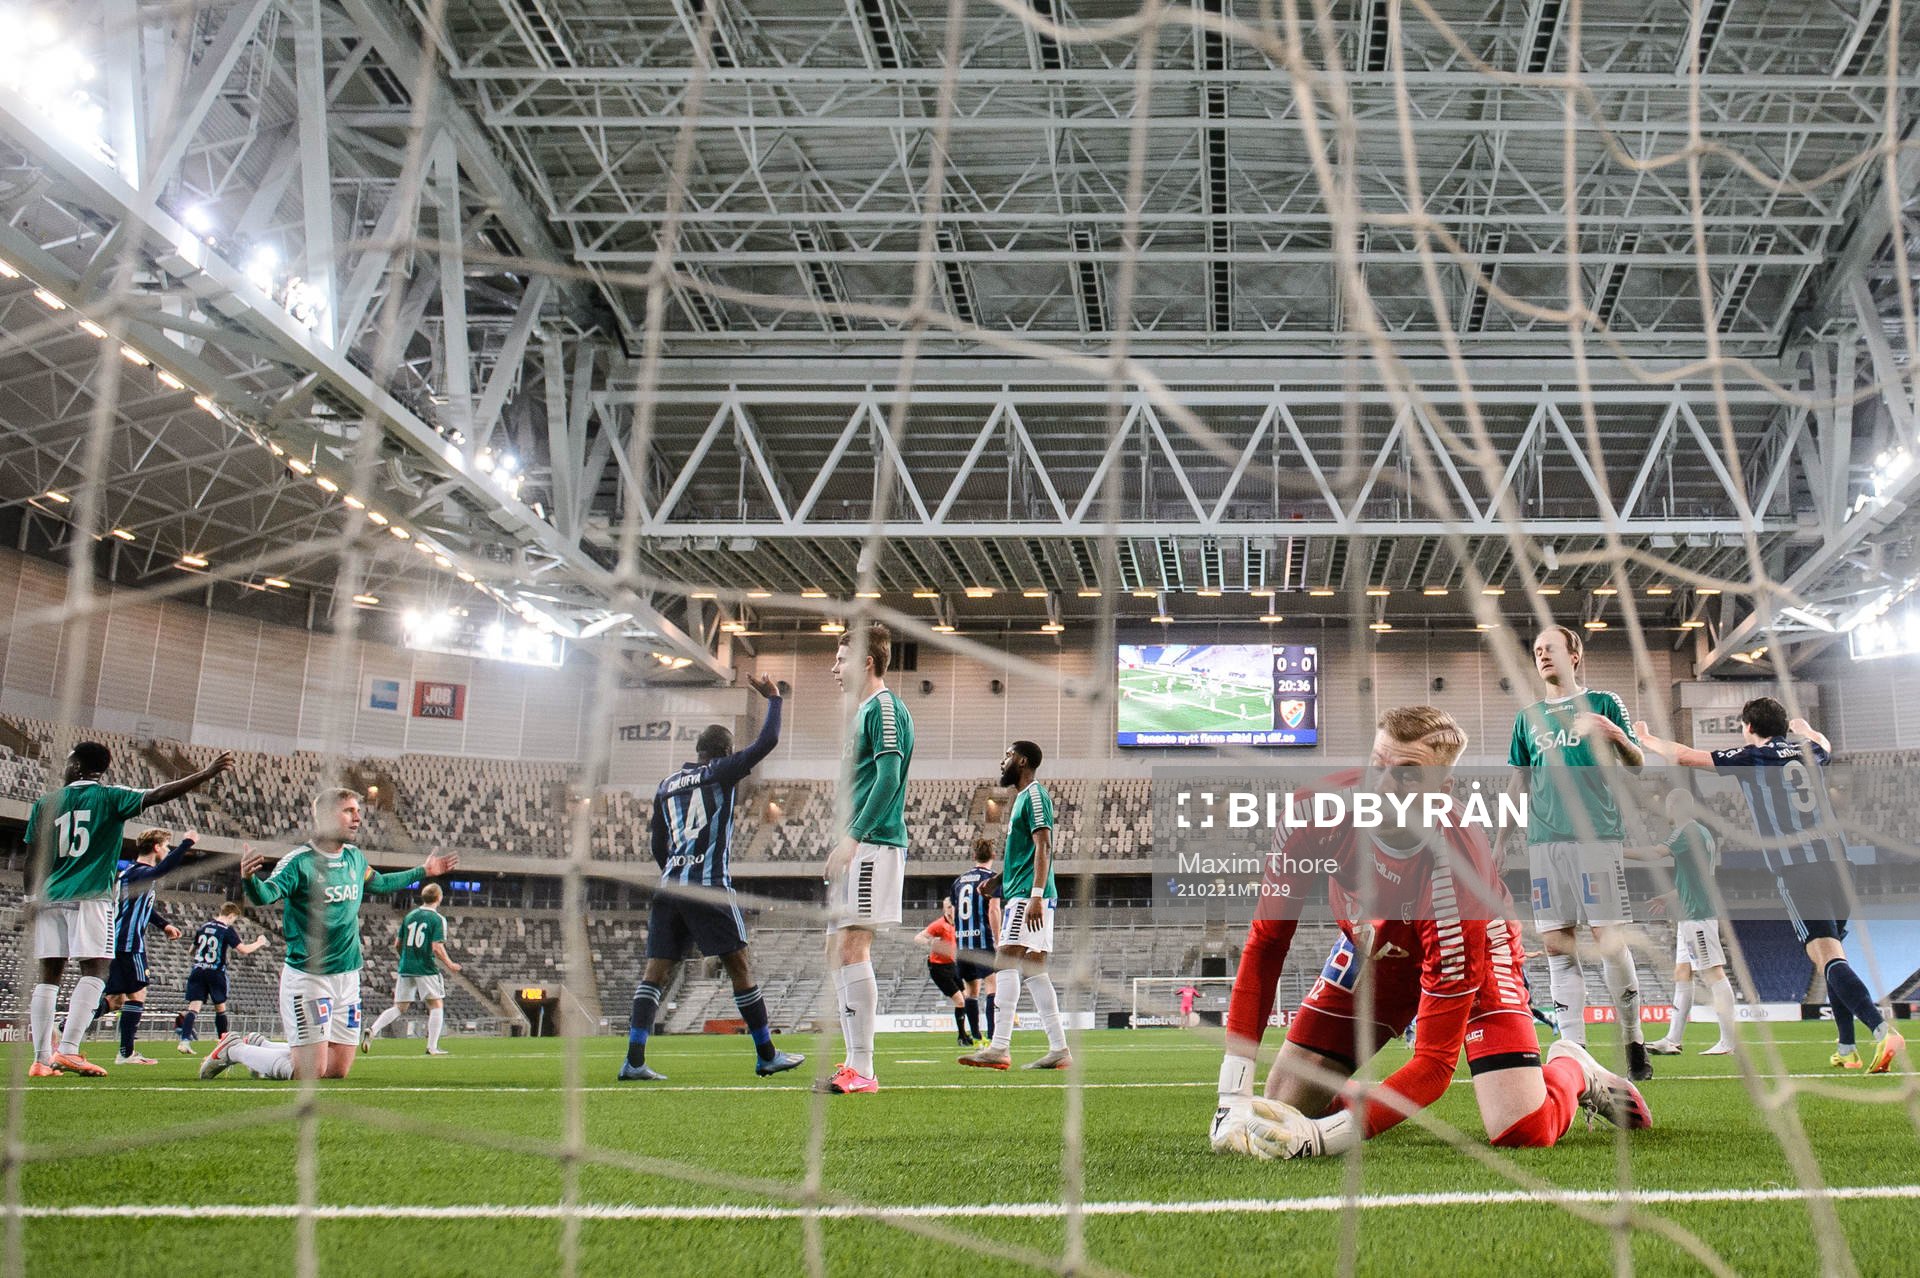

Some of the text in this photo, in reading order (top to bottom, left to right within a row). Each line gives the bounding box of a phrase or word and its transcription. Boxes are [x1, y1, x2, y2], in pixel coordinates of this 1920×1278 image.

[1276, 657, 1287, 671] 0
[1301, 657, 1312, 671] 0
[1278, 680, 1311, 692] 20:36
[422, 705, 454, 717] ZONE
[618, 720, 671, 741] TELE2
[1535, 729, 1581, 754] SSAB
[1783, 760, 1817, 813] 3
[667, 787, 708, 850] 14
[54, 809, 91, 858] 15
[324, 884, 359, 903] SSAB
[958, 884, 974, 920] 6
[407, 921, 427, 948] 16
[194, 934, 219, 963] 23
[1593, 1008, 1676, 1021] BAAUS
